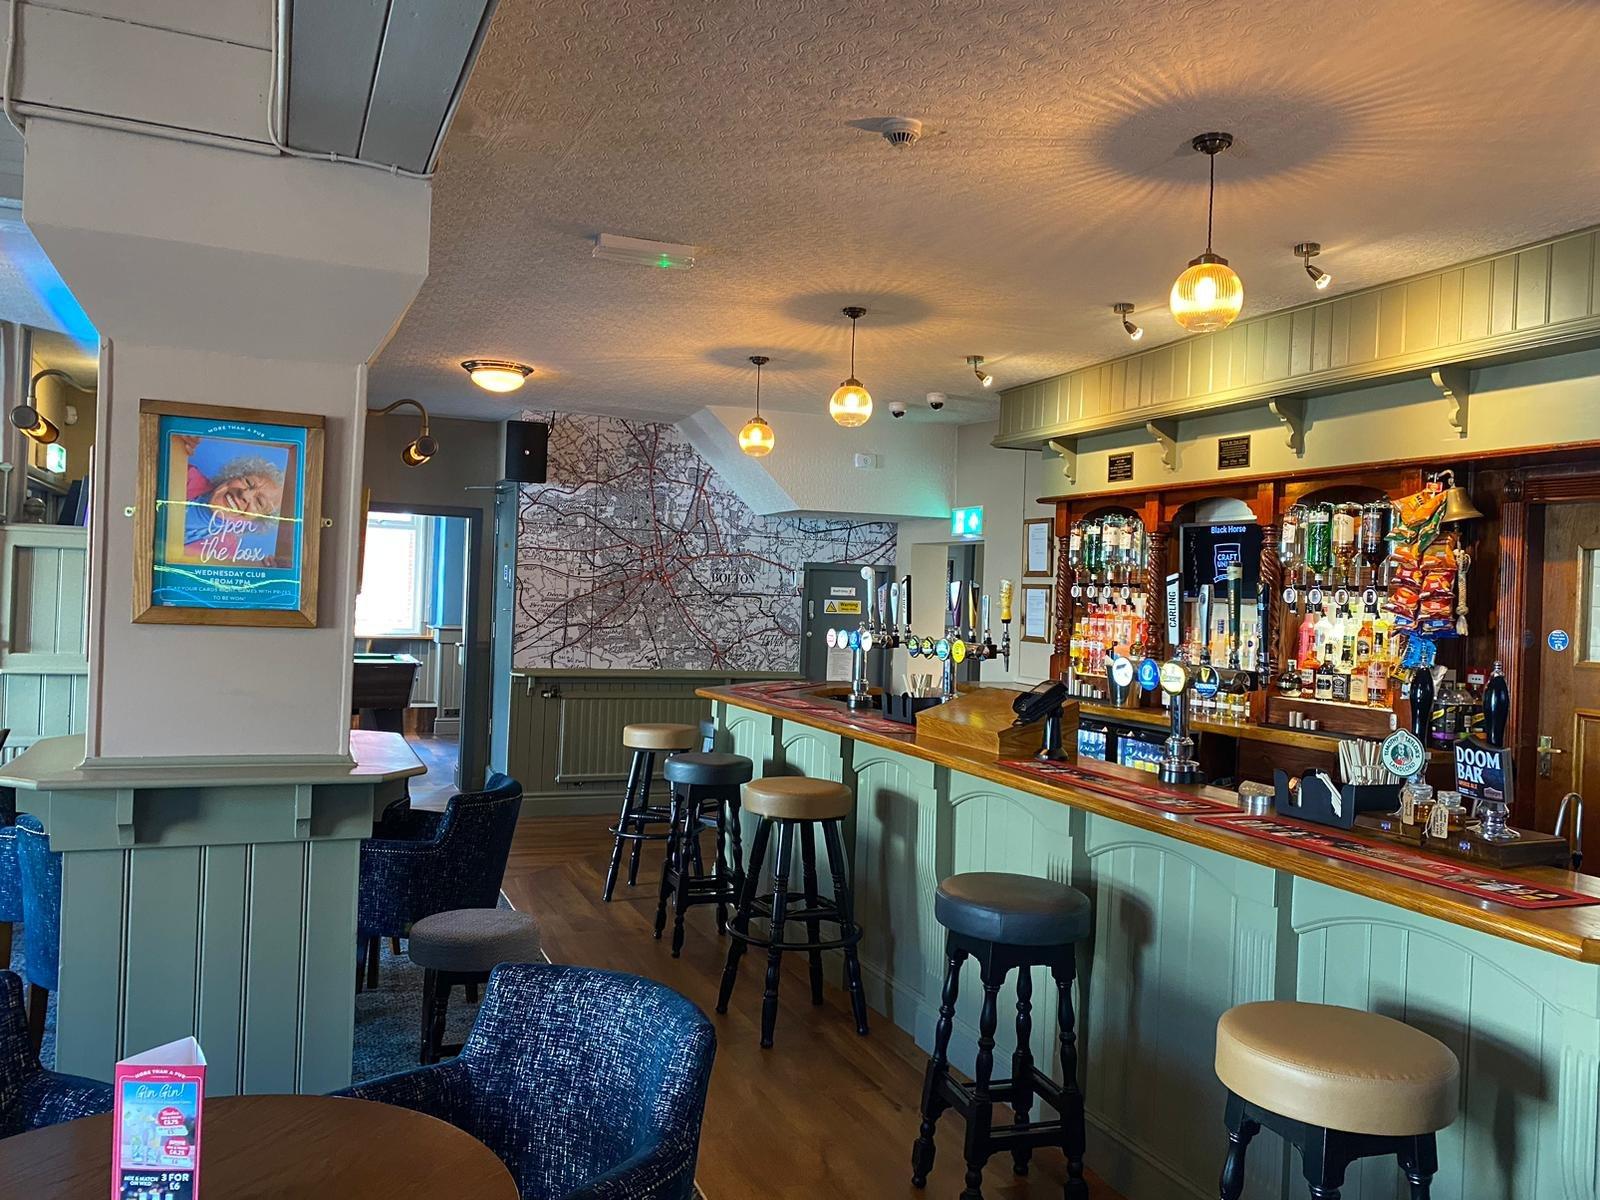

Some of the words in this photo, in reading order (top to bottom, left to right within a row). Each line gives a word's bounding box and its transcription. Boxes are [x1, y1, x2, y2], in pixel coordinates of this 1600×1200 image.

[208, 425, 226, 433] MORE
[207, 510, 256, 542] Open
[1211, 526, 1227, 534] Black
[1228, 525, 1247, 533] Horse
[200, 537, 229, 563] the
[232, 541, 265, 562] box
[1217, 553, 1238, 561] CRAFT
[194, 569, 243, 578] WEDNESDAY
[246, 570, 266, 578] CLUB
[711, 573, 756, 584] BOLTON
[210, 578, 234, 586] FROM
[234, 578, 251, 586] 7PM
[1168, 591, 1177, 628] CARLING
[1384, 736, 1399, 756] TIMOTHY
[1456, 745, 1501, 770] DOOM
[1457, 762, 1486, 785] BAR
[136, 1084, 157, 1100] Gin
[159, 1083, 185, 1101] Gin!
[161, 1173, 167, 1182] 3
[168, 1173, 190, 1182] FOR
[169, 1182, 181, 1191] £6
